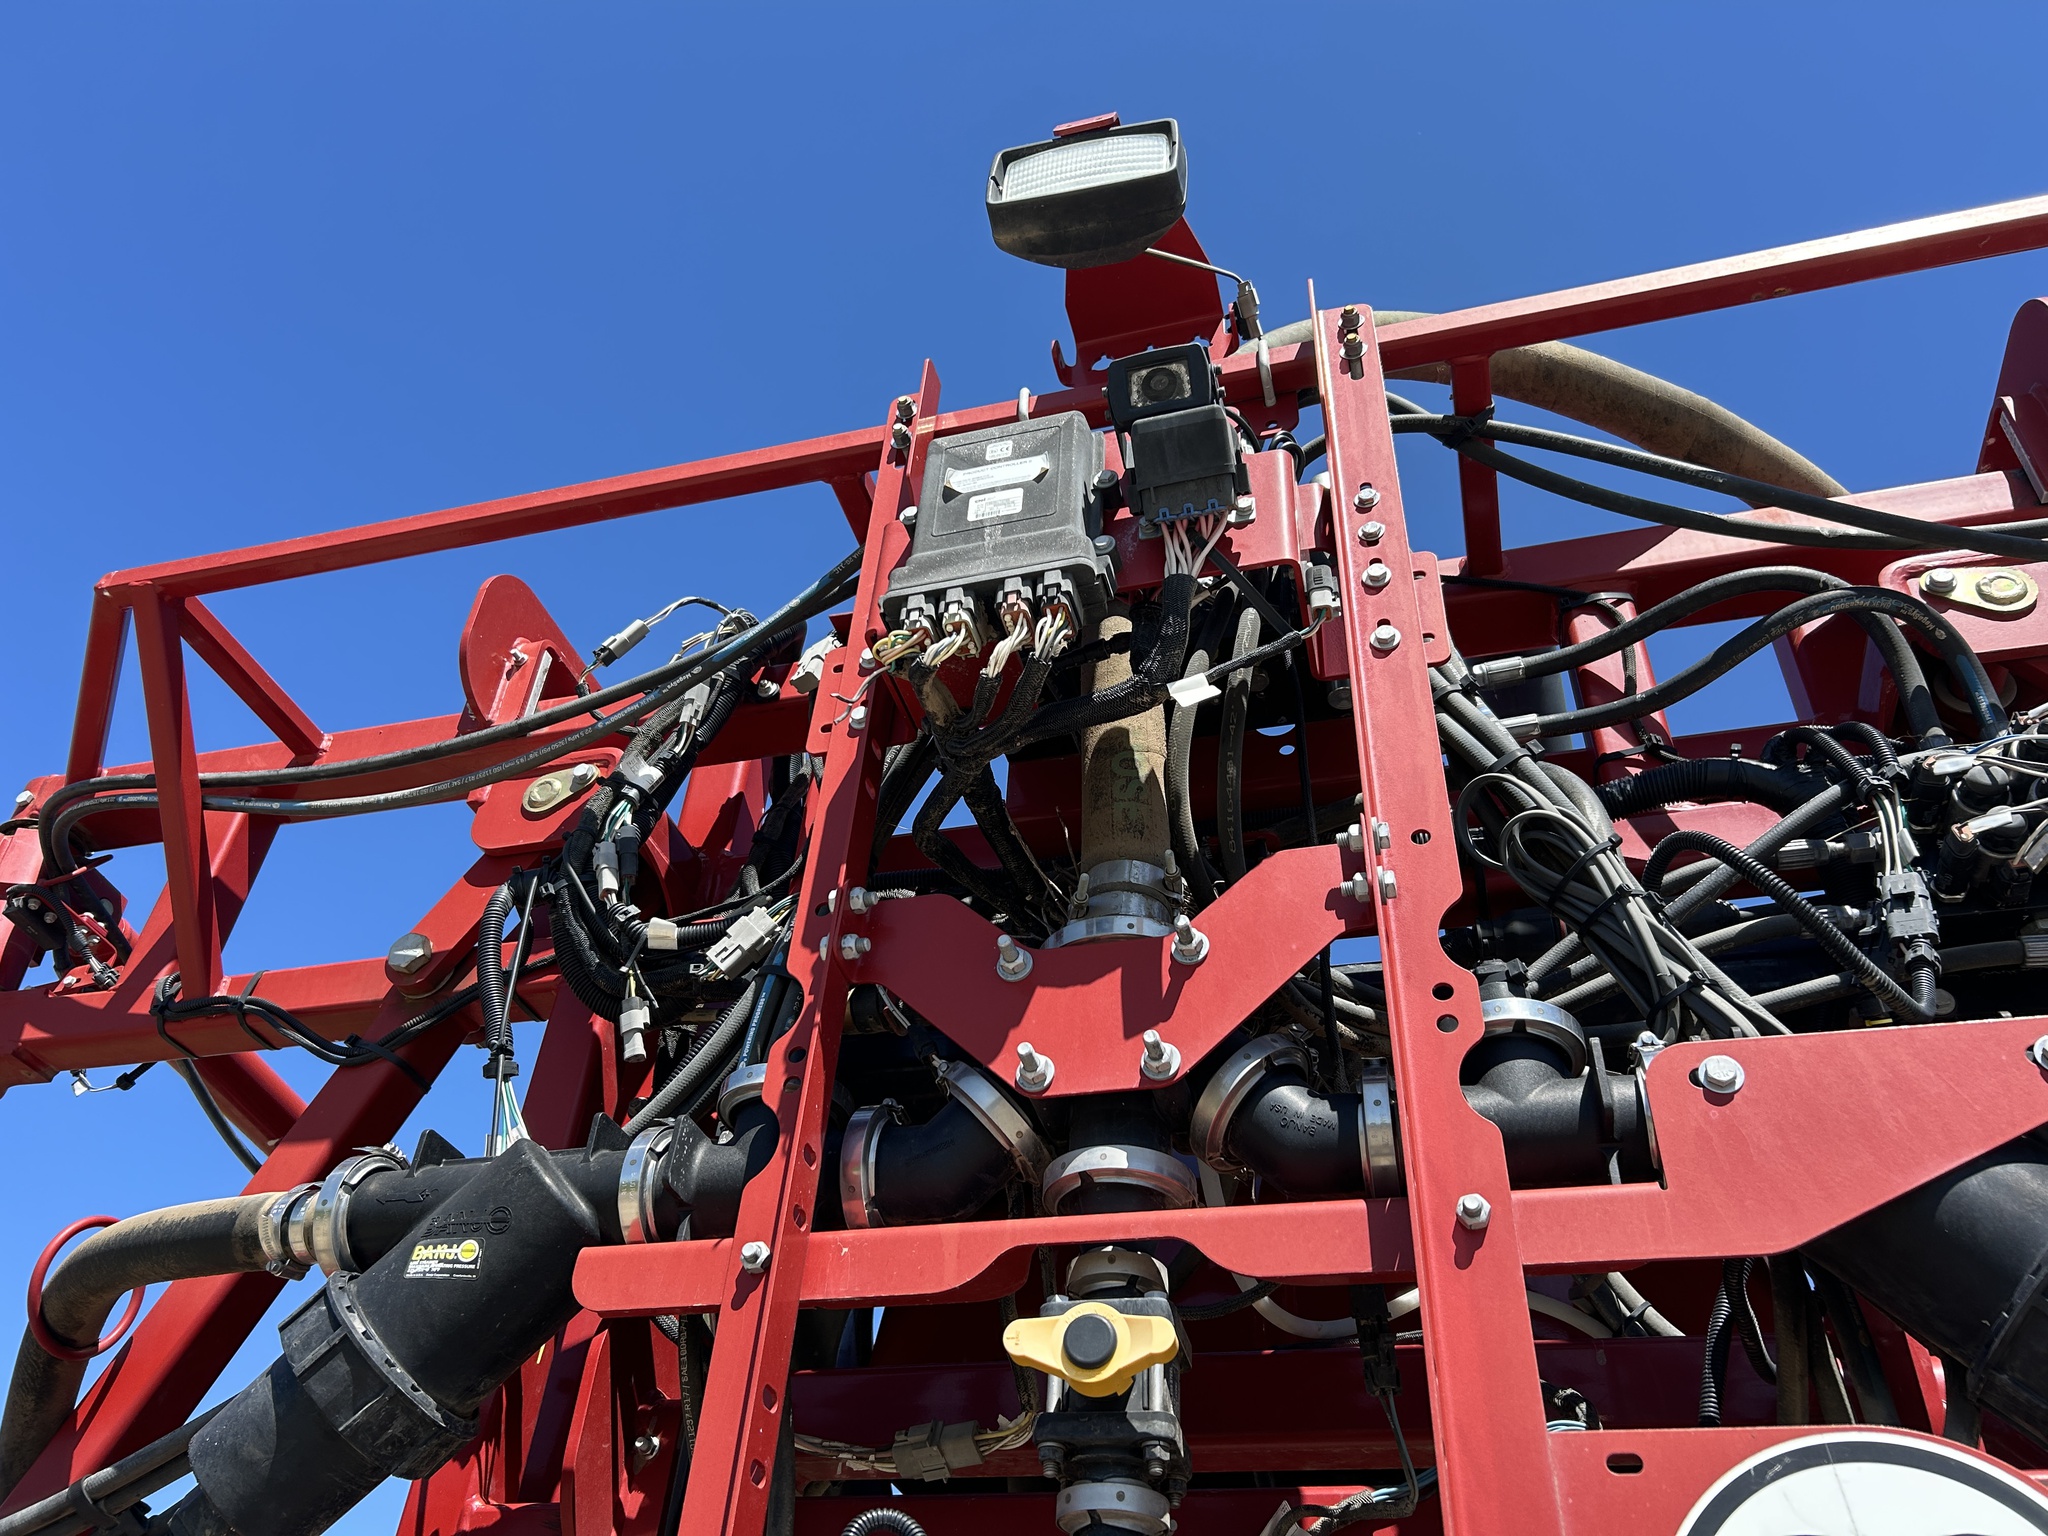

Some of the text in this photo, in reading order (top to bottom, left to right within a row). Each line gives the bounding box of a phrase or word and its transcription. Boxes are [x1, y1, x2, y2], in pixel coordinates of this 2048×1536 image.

[1269, 1103, 1337, 1131] MADE IN USA
[1279, 1117, 1317, 1137] BANJO
